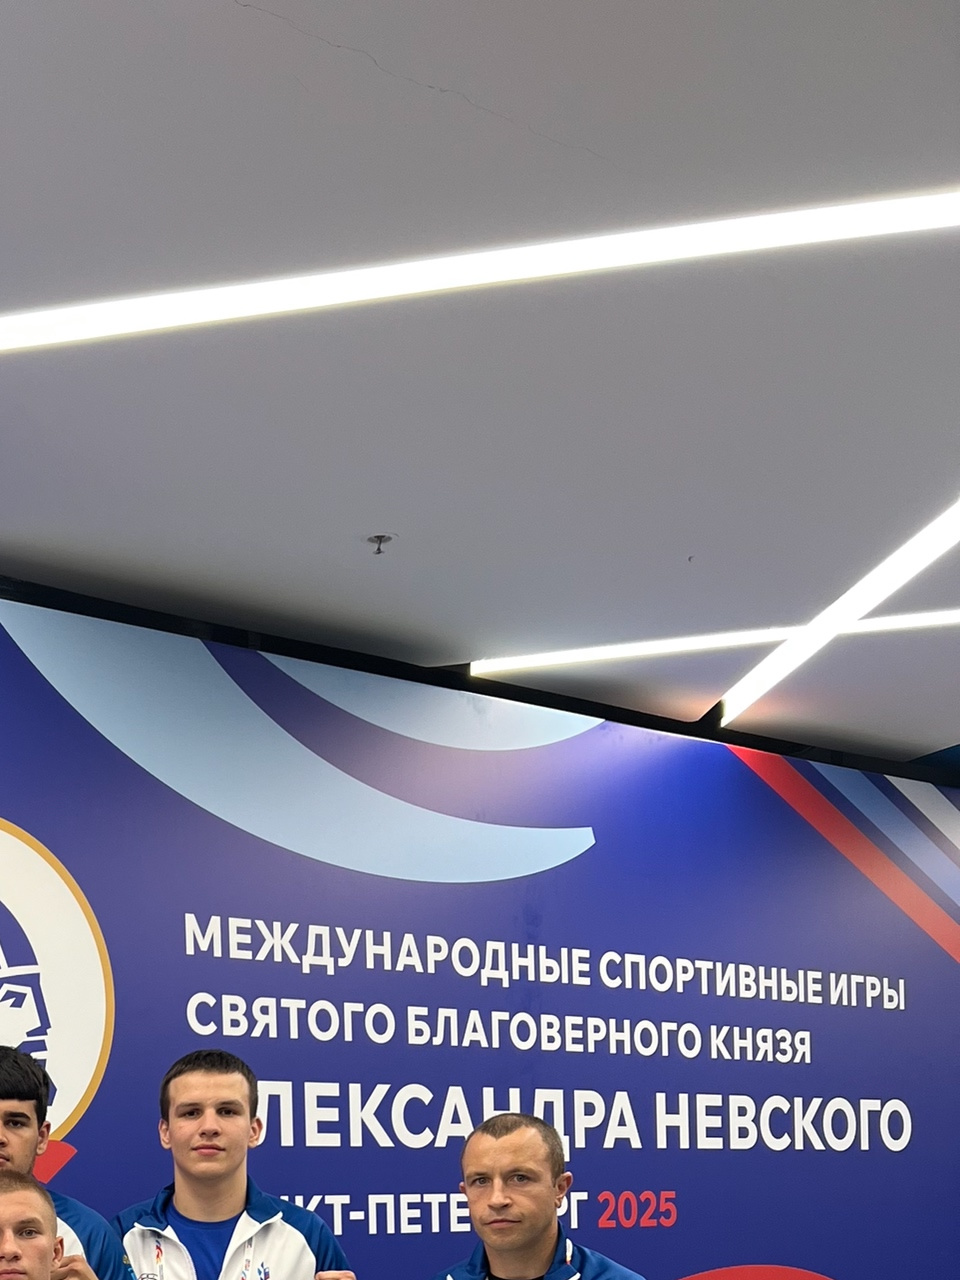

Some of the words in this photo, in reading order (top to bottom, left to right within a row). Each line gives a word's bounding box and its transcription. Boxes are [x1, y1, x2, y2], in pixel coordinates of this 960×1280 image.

[184, 912, 591, 988] МЕЖДУНАРОДНЫЕ
[599, 949, 823, 1005] СПОРТИВНЫЕ
[829, 972, 906, 1011] ИГРЫ
[186, 991, 396, 1045] СВЯТОГО
[406, 1007, 702, 1060] БЛАГОВЕРНОГО
[710, 1025, 813, 1064] КНЯЗЯ
[257, 1080, 642, 1162] ЛЕКСАДРА
[655, 1091, 913, 1152] НЕВСКОГО
[597, 1190, 678, 1229] 2025
